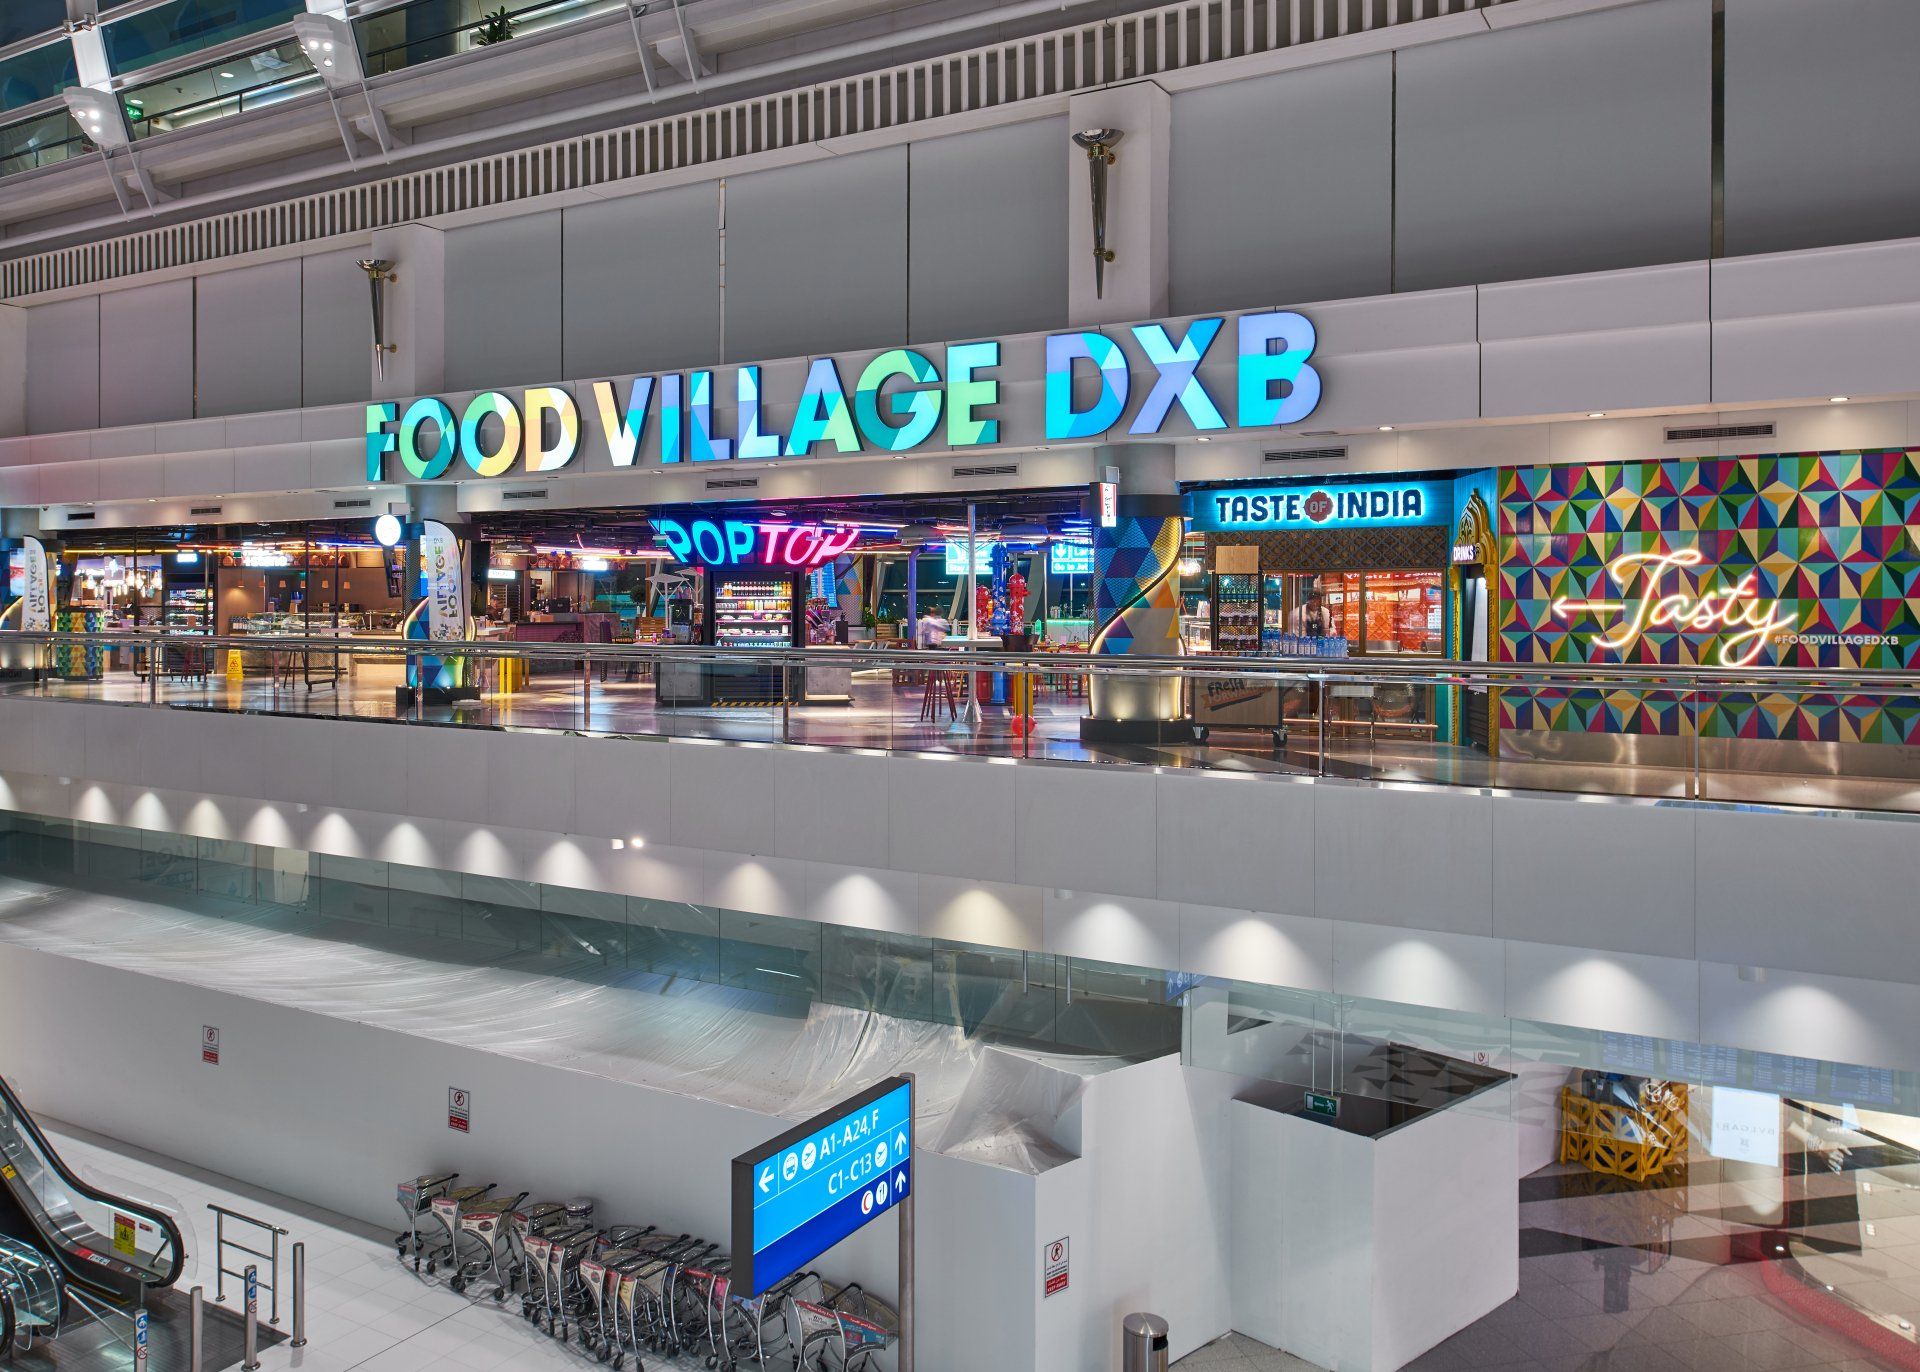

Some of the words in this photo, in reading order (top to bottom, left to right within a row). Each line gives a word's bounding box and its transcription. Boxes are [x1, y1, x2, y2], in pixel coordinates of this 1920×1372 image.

[366, 387, 581, 481] FOOD
[592, 342, 1000, 467] VILLAGE
[1046, 312, 1323, 440] DXB
[1216, 494, 1301, 522] TASTE
[1309, 501, 1328, 513] OF
[1338, 489, 1422, 518] INDIA
[647, 519, 754, 565] POP
[759, 519, 861, 565] TOP
[1453, 545, 1474, 561] DRINKS
[1590, 548, 1799, 667] Tasty
[1774, 634, 1899, 646] #FOODVILLAGEDXB
[872, 1108, 879, 1130] F
[828, 1152, 872, 1195] C1-C13
